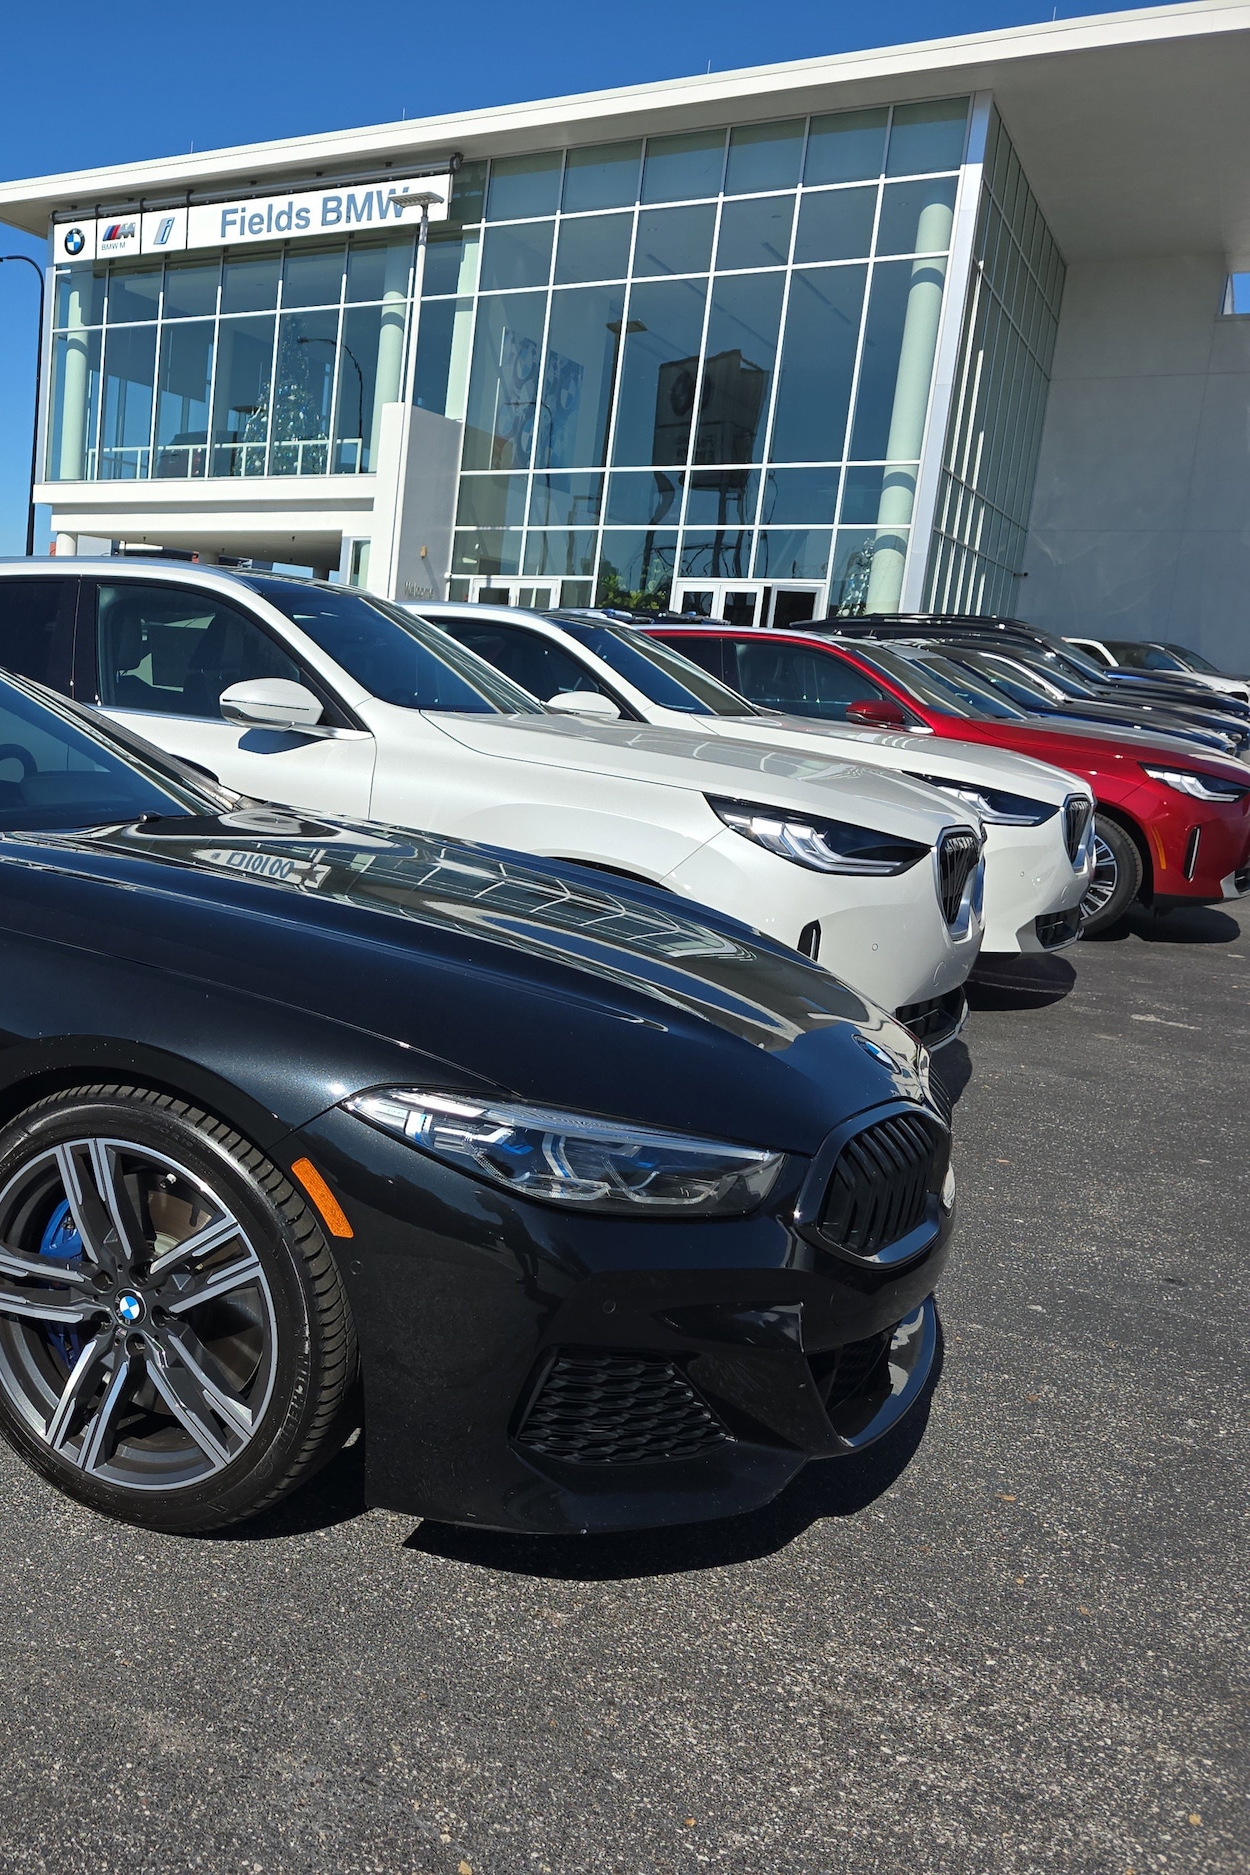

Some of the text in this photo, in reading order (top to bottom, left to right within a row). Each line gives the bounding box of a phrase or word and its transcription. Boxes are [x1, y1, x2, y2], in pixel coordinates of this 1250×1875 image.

[220, 186, 410, 238] Fields BMW
[101, 241, 126, 251] BMW M
